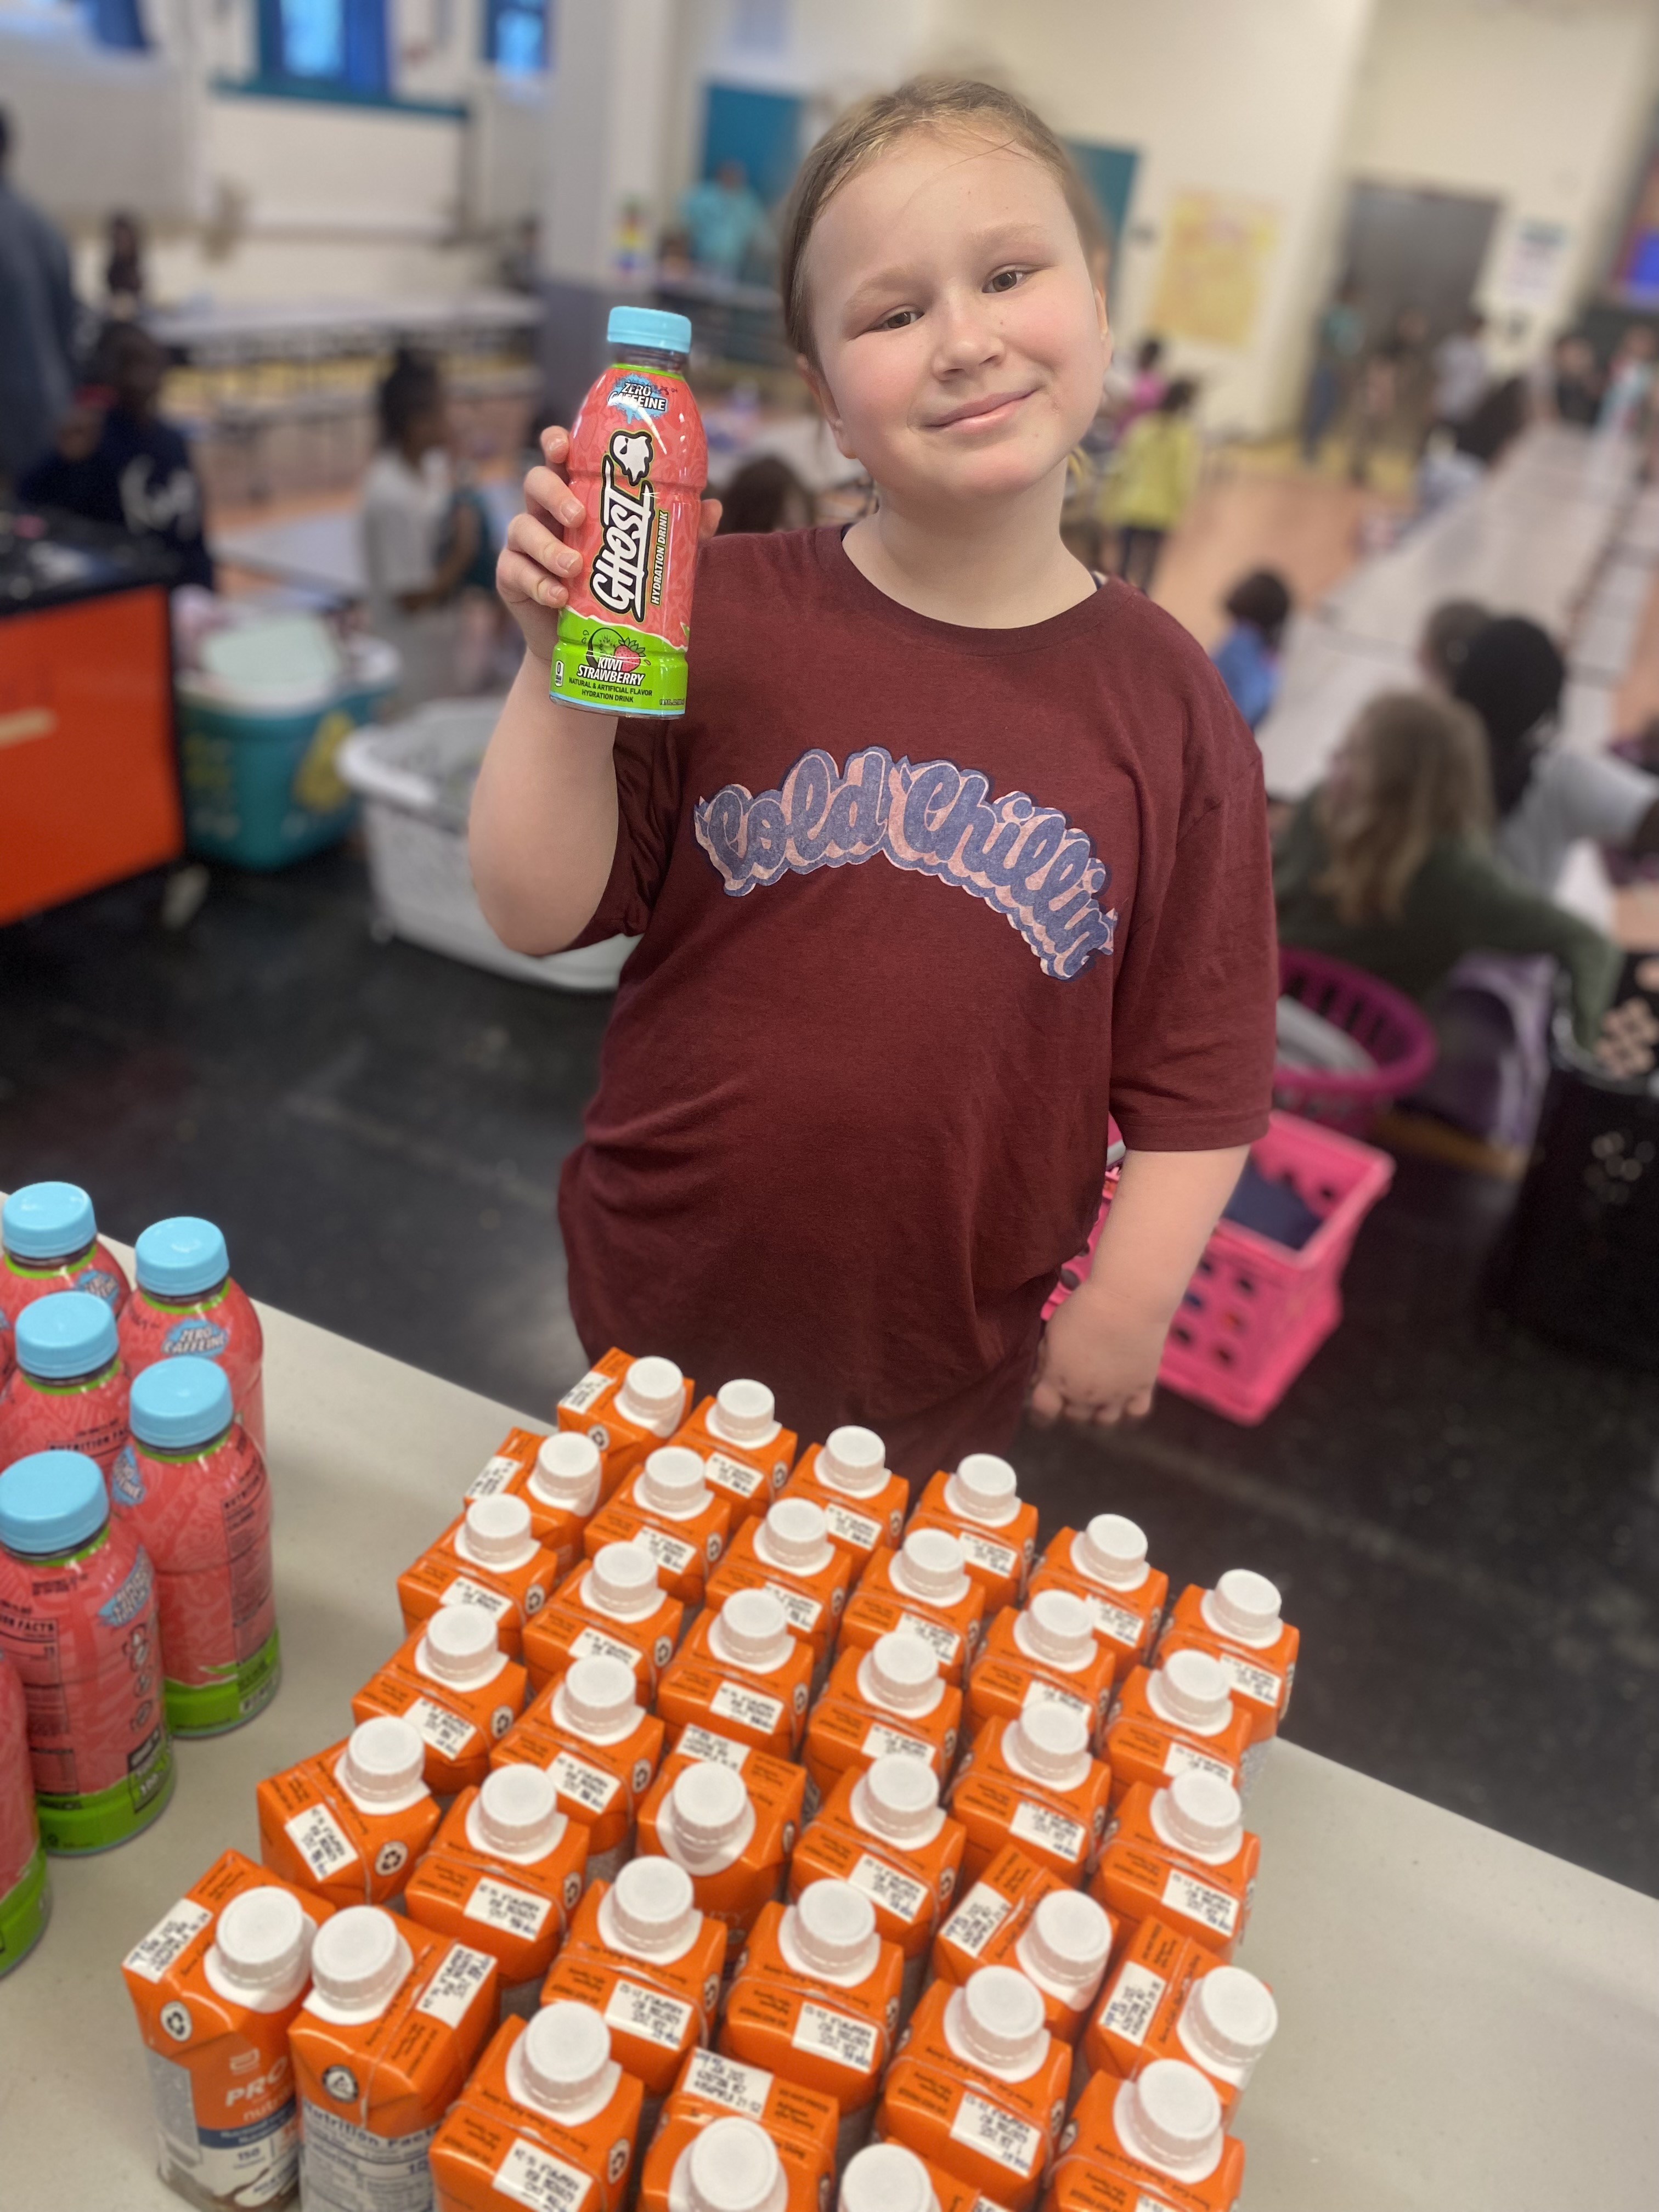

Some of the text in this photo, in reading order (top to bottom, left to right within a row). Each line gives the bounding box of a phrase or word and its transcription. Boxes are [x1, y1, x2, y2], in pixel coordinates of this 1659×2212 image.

[621, 382, 652, 397] ZERO
[591, 459, 652, 619] GHOST
[652, 511, 668, 605] HYDRATION DRINK
[597, 657, 623, 671] KIWI
[577, 664, 645, 686] STRAWBERRY
[568, 676, 591, 689] NATURAL
[597, 684, 629, 694] ARTIFICIAL
[630, 688, 653, 696] FLAVOR
[582, 689, 634, 703] HYDRATION DRINK
[694, 747, 889, 896] Cold
